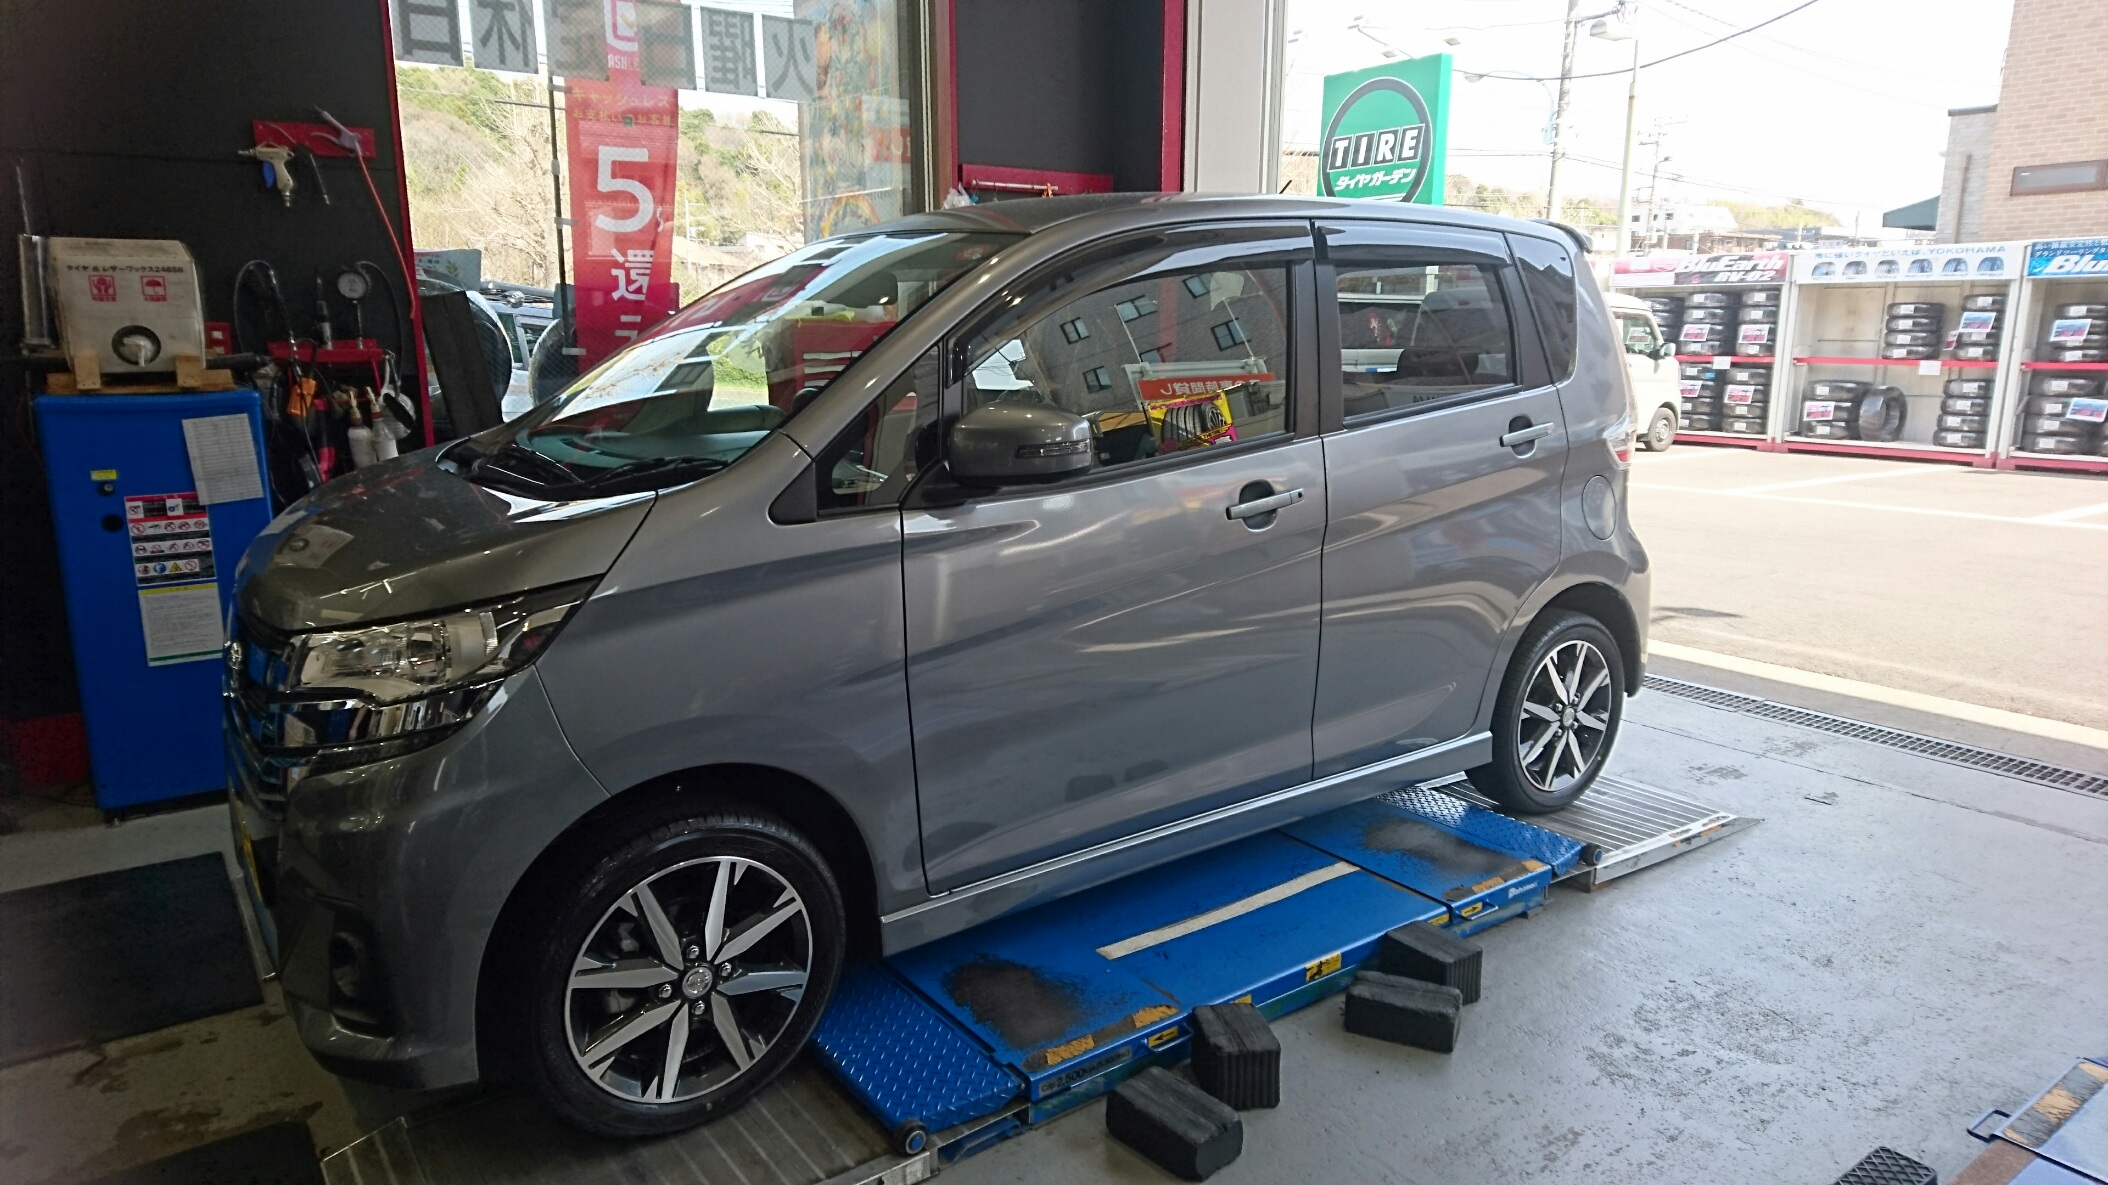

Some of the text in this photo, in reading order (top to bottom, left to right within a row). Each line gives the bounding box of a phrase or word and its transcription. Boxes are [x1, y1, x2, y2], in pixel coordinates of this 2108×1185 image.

[572, 87, 669, 108] キャッシュレス
[1334, 129, 1419, 167] TIRE
[1335, 167, 1417, 191] タイヤガーデン
[1929, 245, 2006, 255] YOKOHAMA
[1676, 254, 1784, 273] BluEarth
[2043, 254, 2108, 273] Blu
[1713, 270, 1777, 282] RV-02
